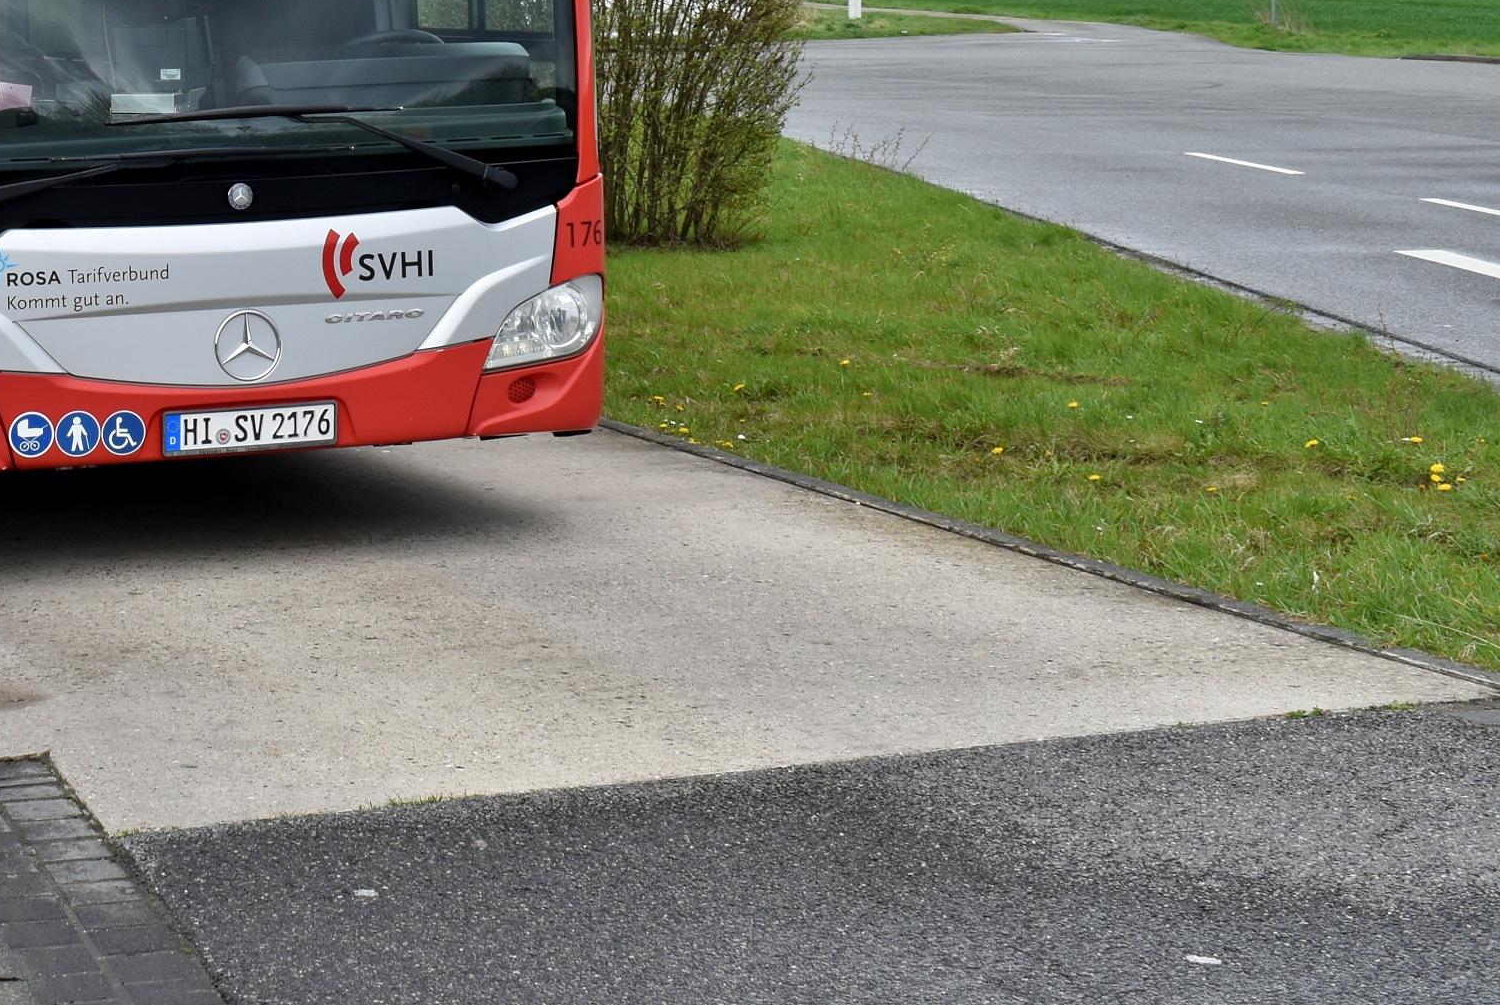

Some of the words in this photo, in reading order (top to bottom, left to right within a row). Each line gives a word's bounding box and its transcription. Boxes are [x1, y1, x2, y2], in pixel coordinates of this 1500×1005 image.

[566, 219, 602, 248] 176
[6, 270, 62, 287] ROSA
[67, 264, 170, 284] Tarifverbund
[358, 249, 434, 282] SVHI
[7, 295, 68, 311] Kommt
[73, 293, 100, 312] gut
[105, 293, 130, 306] an.
[324, 308, 425, 324] CITARO
[183, 417, 213, 446] HI
[234, 413, 264, 443] SV
[272, 408, 331, 440] 2176
[169, 437, 176, 445] D
